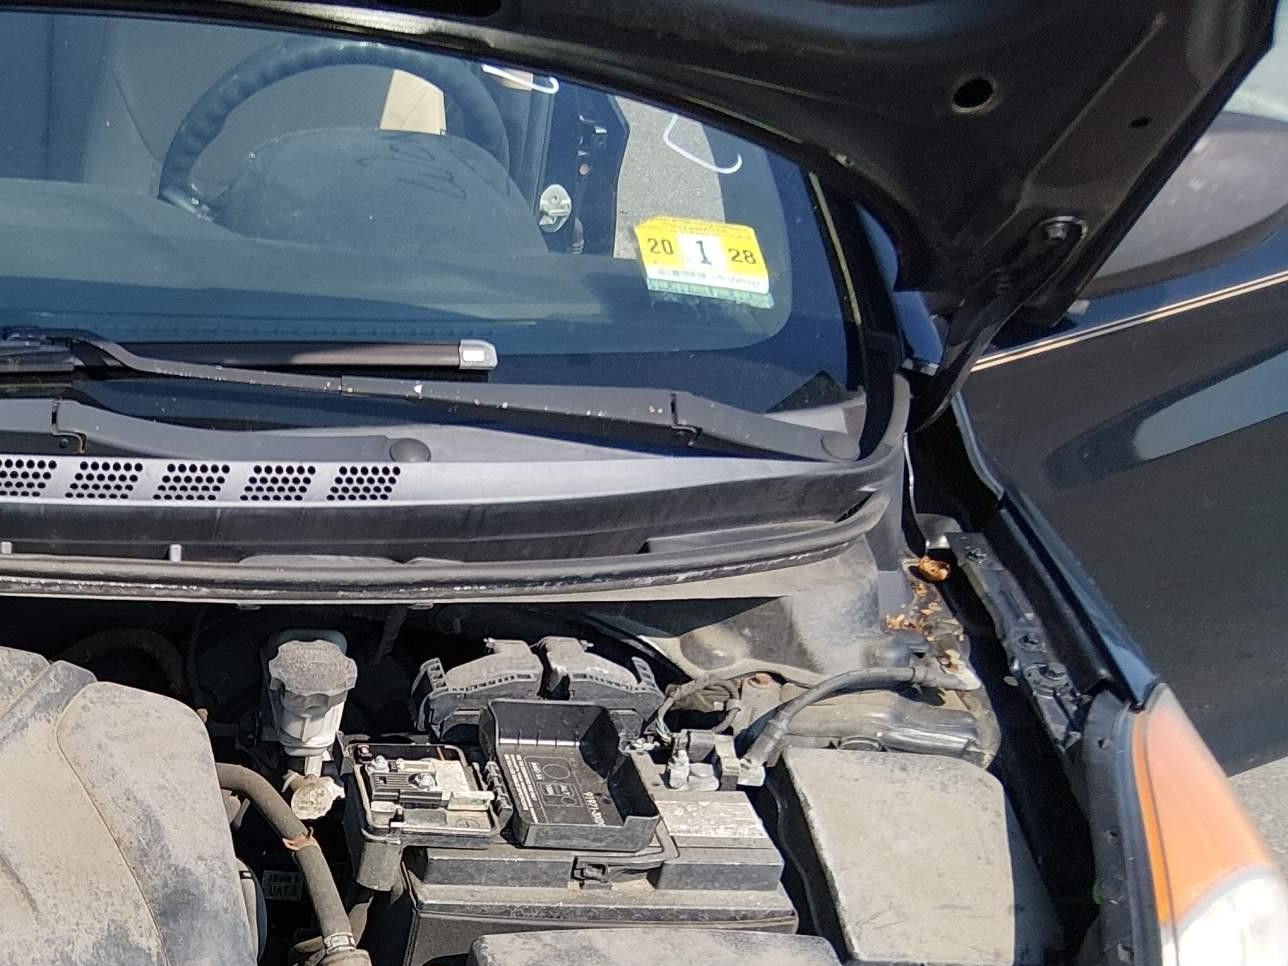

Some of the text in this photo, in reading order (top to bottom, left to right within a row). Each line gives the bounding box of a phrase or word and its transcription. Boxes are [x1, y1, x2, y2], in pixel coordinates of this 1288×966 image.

[647, 237, 757, 265] 20 1 28
